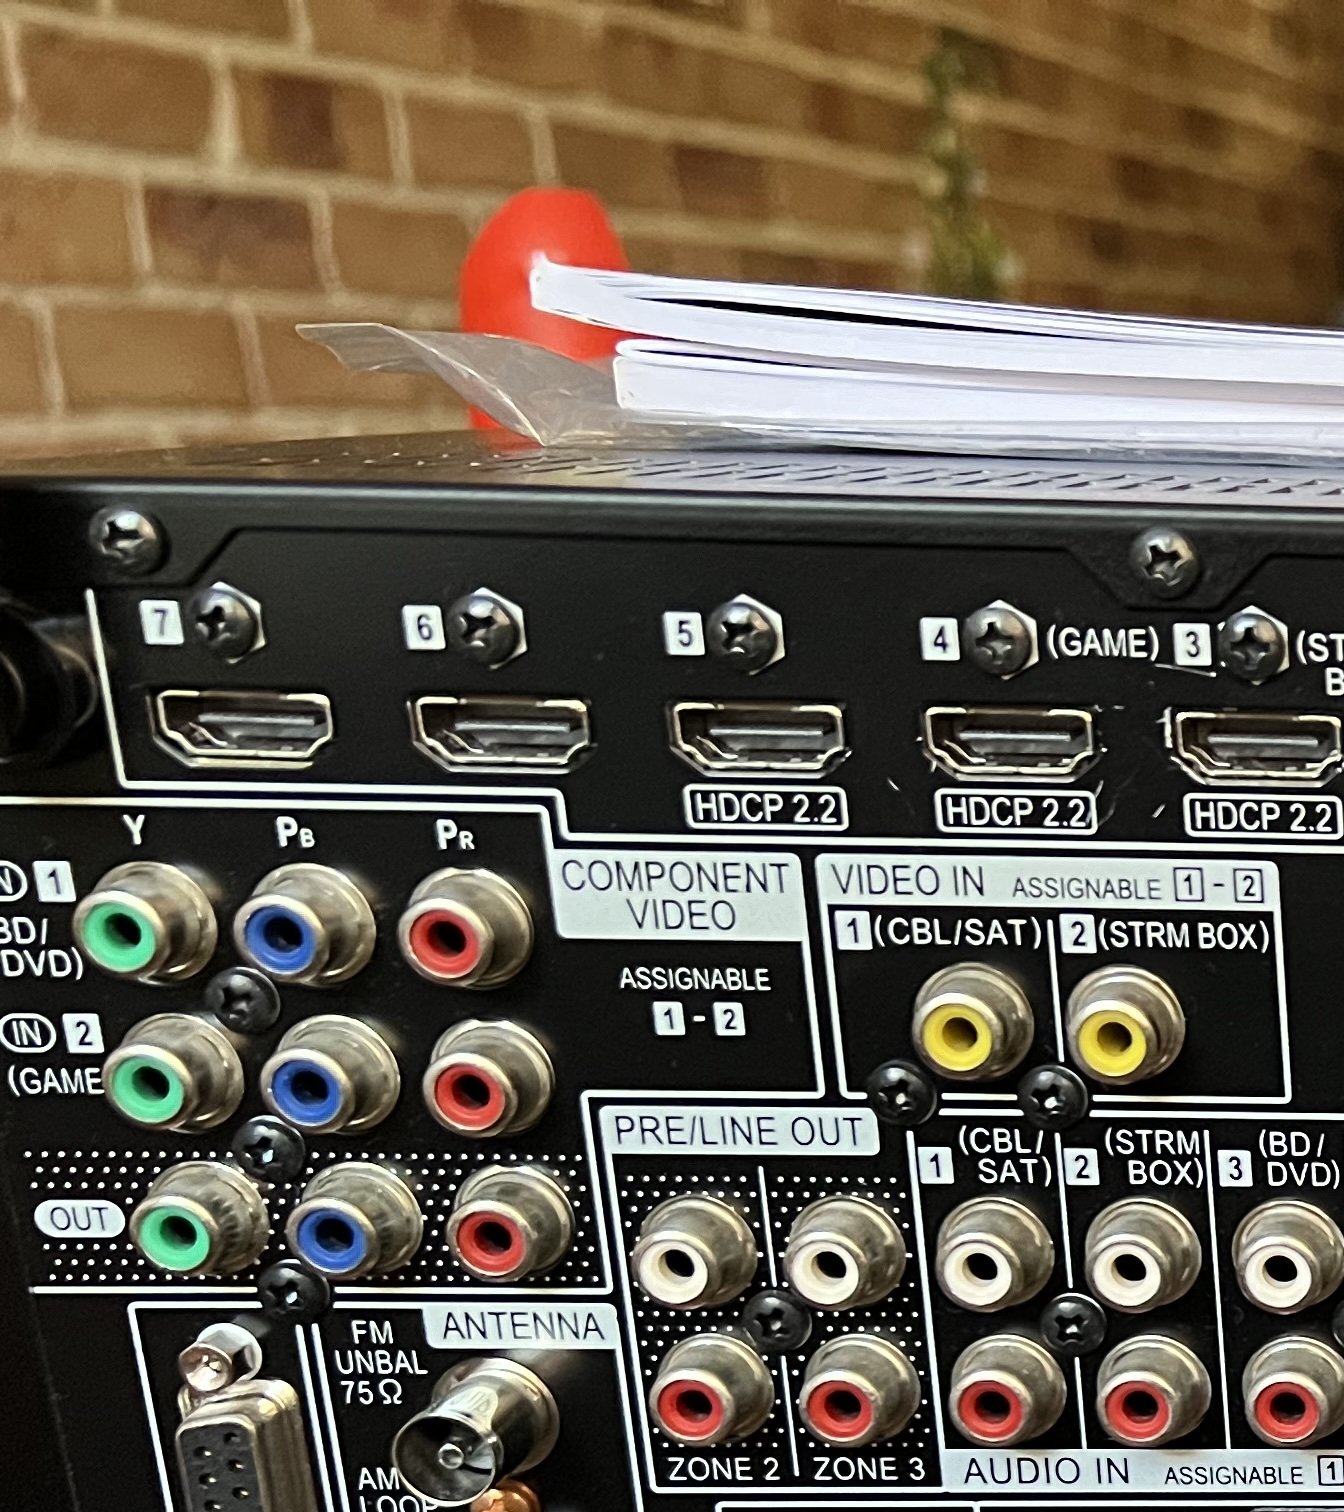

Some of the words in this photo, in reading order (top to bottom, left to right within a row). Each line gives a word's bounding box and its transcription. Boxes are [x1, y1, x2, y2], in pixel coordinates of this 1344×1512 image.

[562, 860, 789, 893] COMPONENT
[831, 864, 939, 895] VIDEO
[953, 866, 984, 896] IN
[1013, 877, 1161, 900] ASSIGNABLE
[626, 899, 735, 930] VIDEO
[621, 967, 771, 990] ASSIGNABLE
[615, 1116, 778, 1145] PRE/LINE
[792, 1117, 862, 1145] OUT
[444, 1312, 605, 1340] ANTENNA
[964, 1458, 1080, 1484] AUDIO
[1097, 1458, 1129, 1483] IN
[1165, 1467, 1303, 1485] ASSIGNABLE
